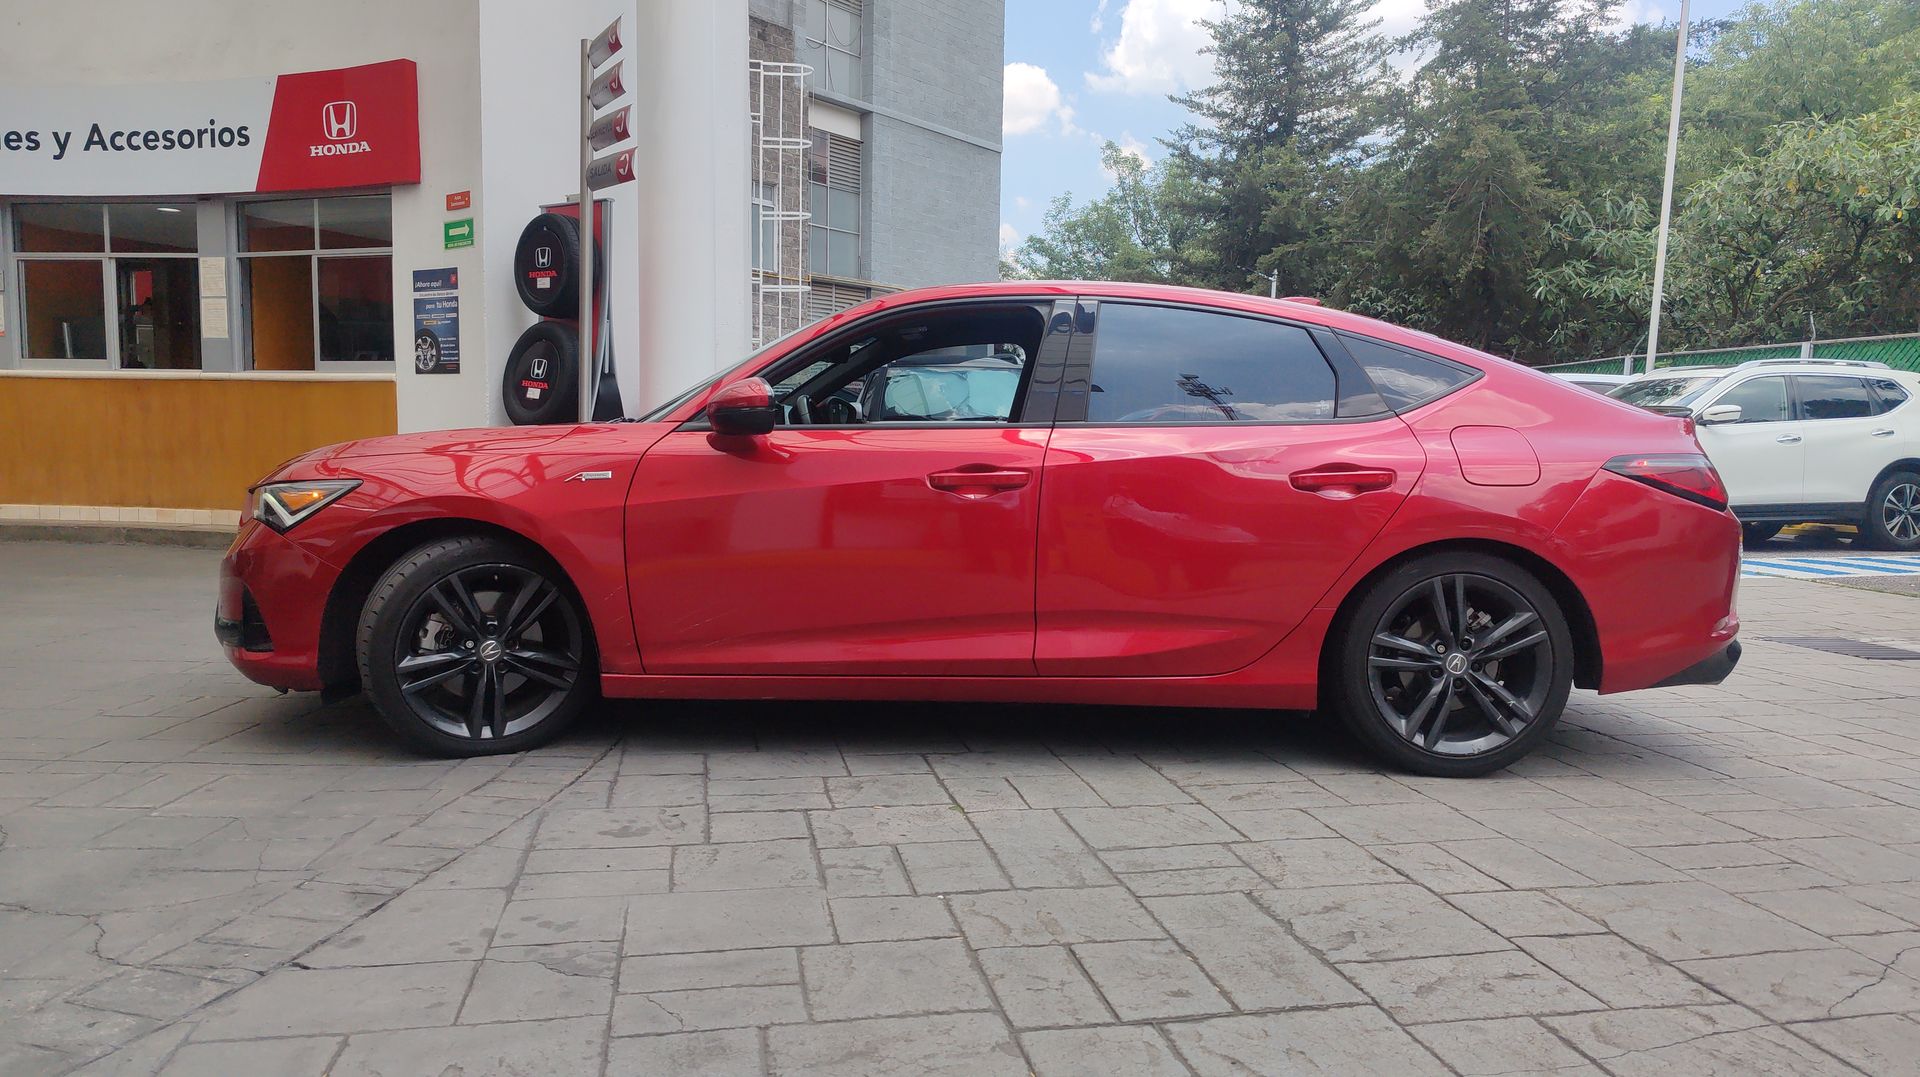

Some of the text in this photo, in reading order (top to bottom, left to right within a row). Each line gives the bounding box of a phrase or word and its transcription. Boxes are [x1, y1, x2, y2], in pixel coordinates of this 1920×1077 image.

[52, 131, 72, 160] y
[83, 118, 250, 151] Accesorios
[309, 141, 372, 157] HONDA
[528, 270, 558, 279] HONDA
[522, 380, 549, 389] HONDA
